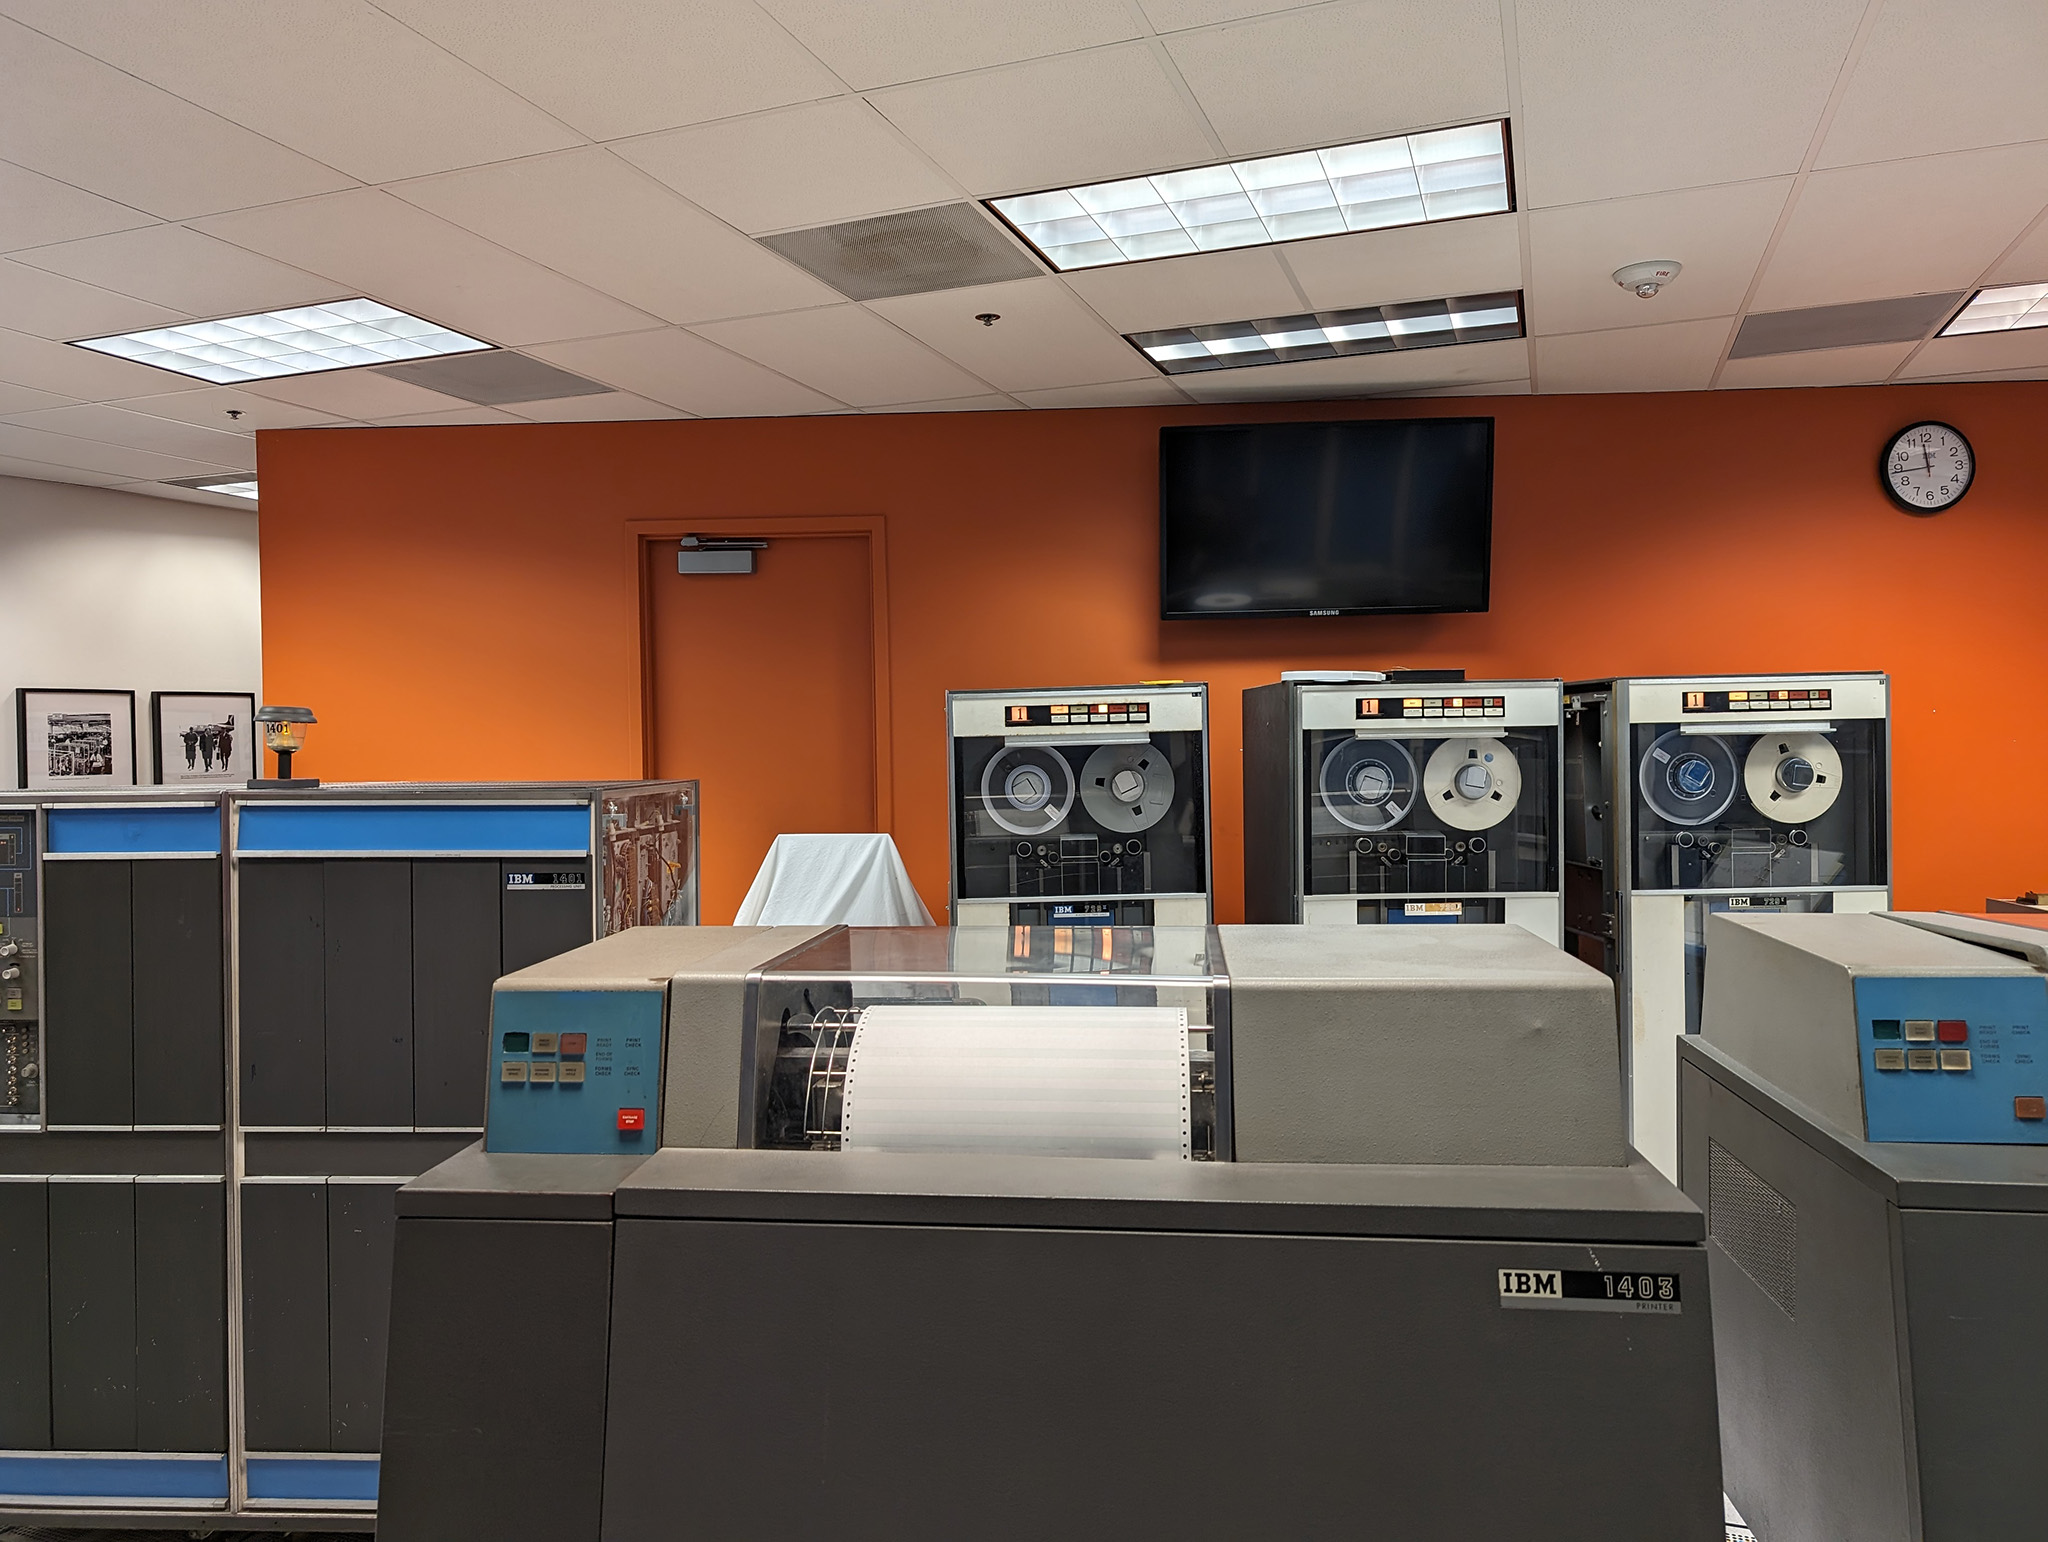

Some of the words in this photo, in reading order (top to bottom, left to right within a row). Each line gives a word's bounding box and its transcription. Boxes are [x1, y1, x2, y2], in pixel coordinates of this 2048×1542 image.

[1907, 438, 1916, 448] 11
[1919, 433, 1932, 443] 12
[1941, 436, 1945, 446] 1
[1896, 452, 1909, 462] 10
[1949, 447, 1958, 457] 2
[1893, 463, 1903, 474] 9
[1955, 460, 1964, 470] 3
[1901, 476, 1910, 486] 8
[1950, 474, 1959, 484] 4
[1913, 487, 1920, 496] 7
[1926, 491, 1934, 500] 6
[1940, 486, 1949, 495] 5
[1692, 694, 1699, 707] 1
[1366, 701, 1372, 713] 1
[1017, 708, 1023, 720] 1
[266, 723, 289, 734] 1401
[508, 873, 534, 884] IBM
[552, 873, 583, 884] 1401
[1055, 905, 1072, 913] IBM
[1405, 904, 1424, 912] IBM
[1503, 1273, 1557, 1295] IBM
[1604, 1275, 1674, 1299] 1403
[1636, 1302, 1674, 1311] PRINTER
